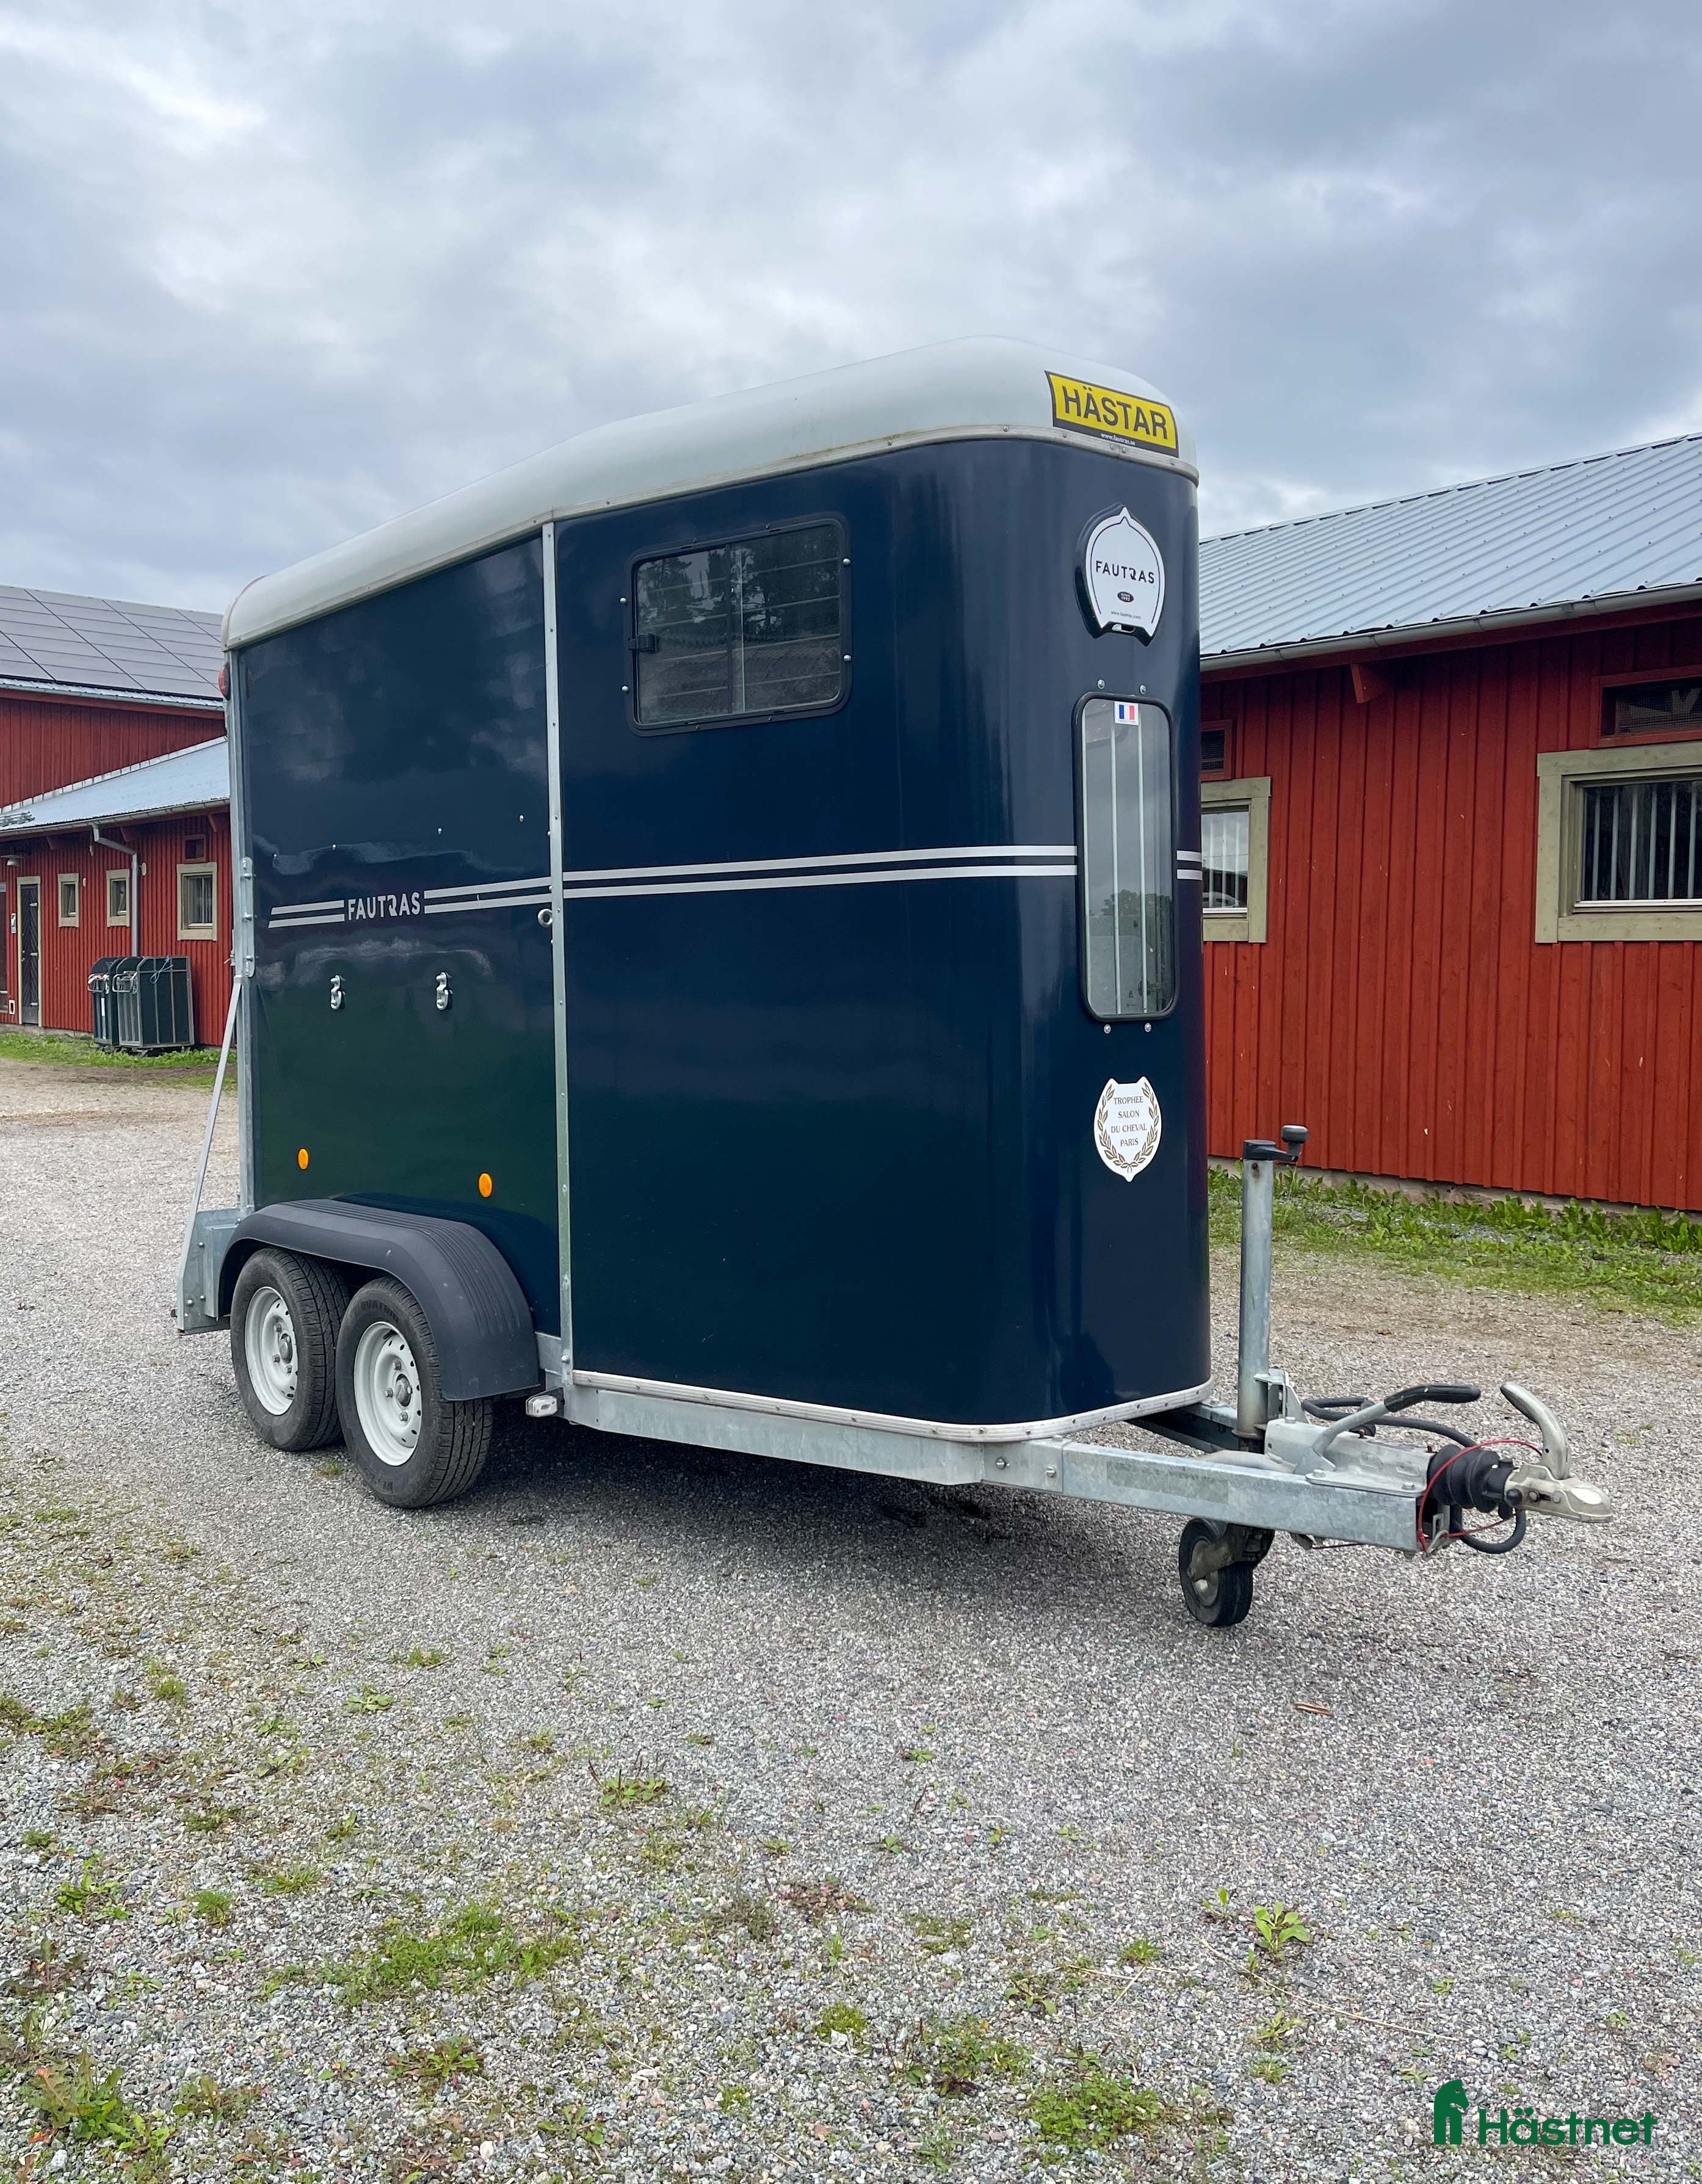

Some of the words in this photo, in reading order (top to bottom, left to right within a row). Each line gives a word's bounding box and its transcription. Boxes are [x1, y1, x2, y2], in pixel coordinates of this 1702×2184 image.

[1062, 385, 1168, 440] HÄSTAR
[1096, 560, 1154, 584] FAUTRAS
[347, 891, 421, 921] FAUTRAS
[1113, 1096, 1143, 1105] TROPHEE
[1118, 1109, 1140, 1119] SALON
[1122, 1123, 1148, 1133] CHEVAL
[1120, 1137, 1139, 1147] PARIS
